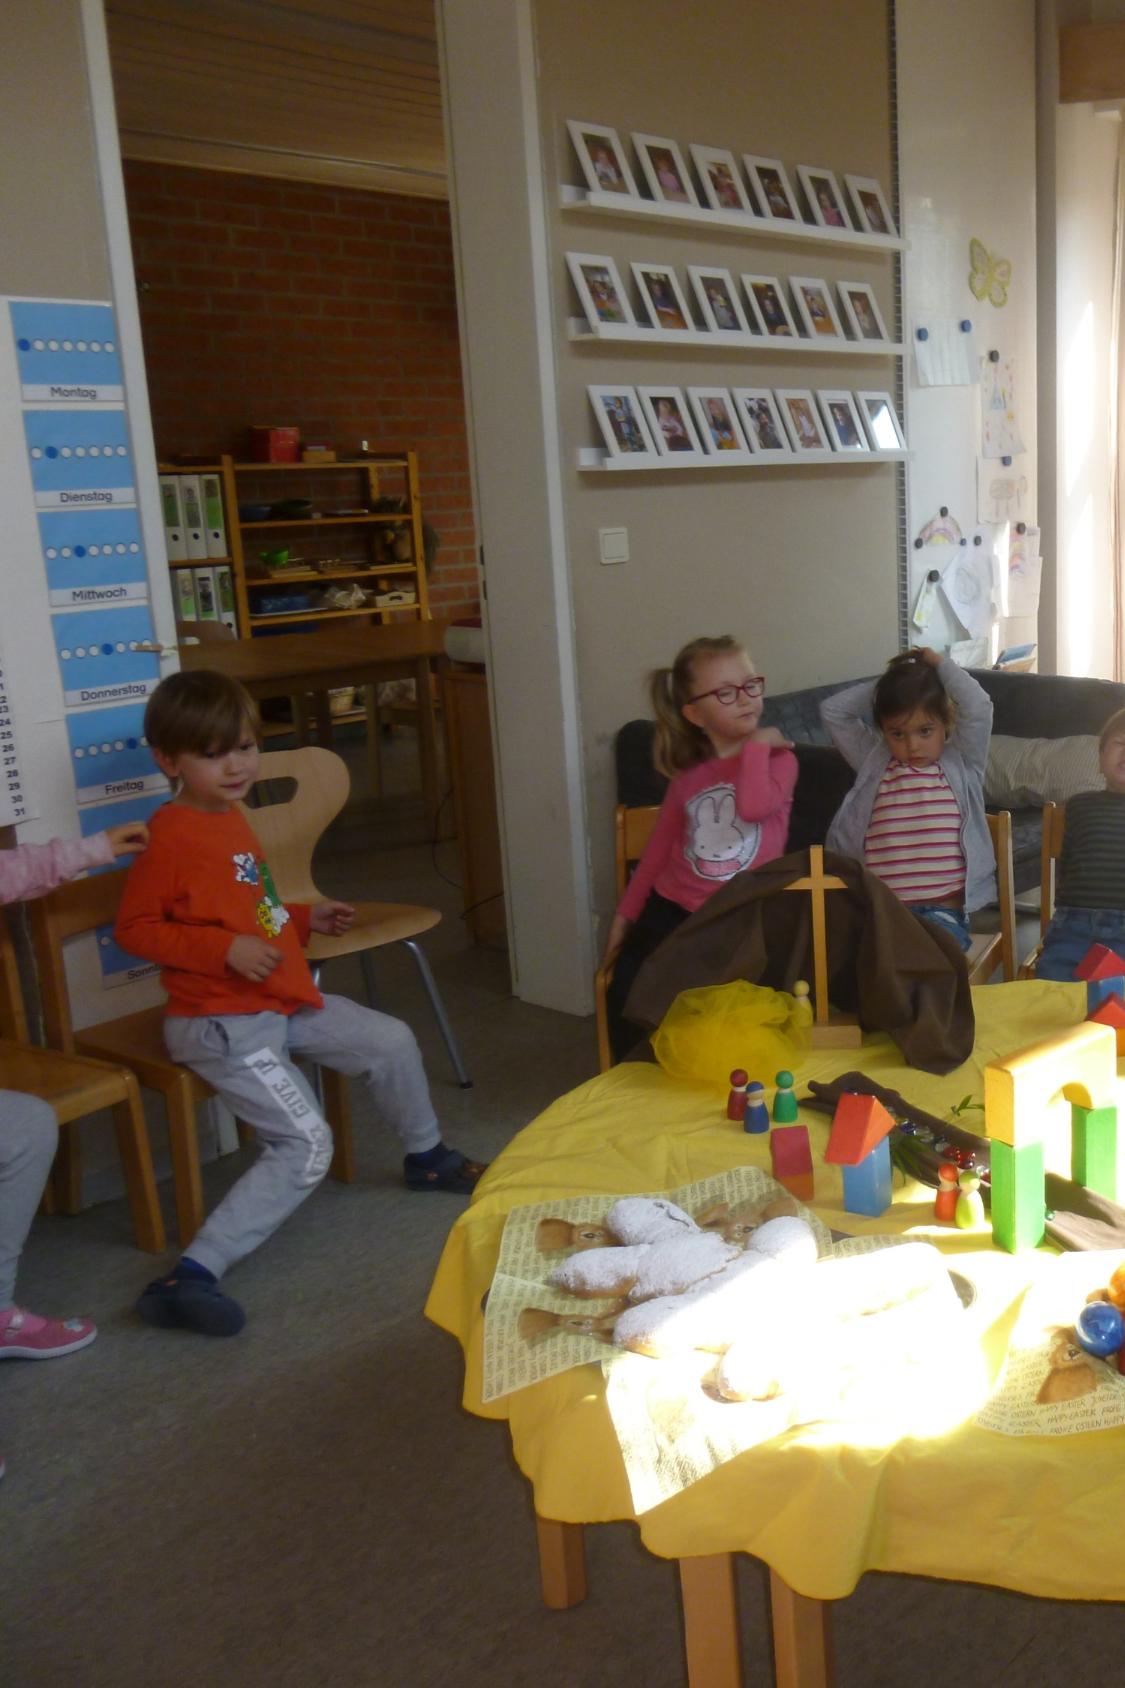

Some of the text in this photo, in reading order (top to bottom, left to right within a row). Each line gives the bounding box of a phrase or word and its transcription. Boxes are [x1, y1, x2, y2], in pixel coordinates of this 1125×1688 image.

[50, 386, 98, 400] Montag
[59, 490, 113, 506] Dienstag
[72, 587, 128, 601] Mittwoch
[80, 683, 147, 702] Donnerstag
[0, 731, 13, 740] 25
[2, 744, 15, 753] 26
[4, 757, 16, 766] 27
[6, 769, 19, 778] 28
[8, 782, 20, 791] 29
[104, 780, 144, 796] Freitag
[11, 795, 23, 804] 30
[14, 808, 26, 817] 31
